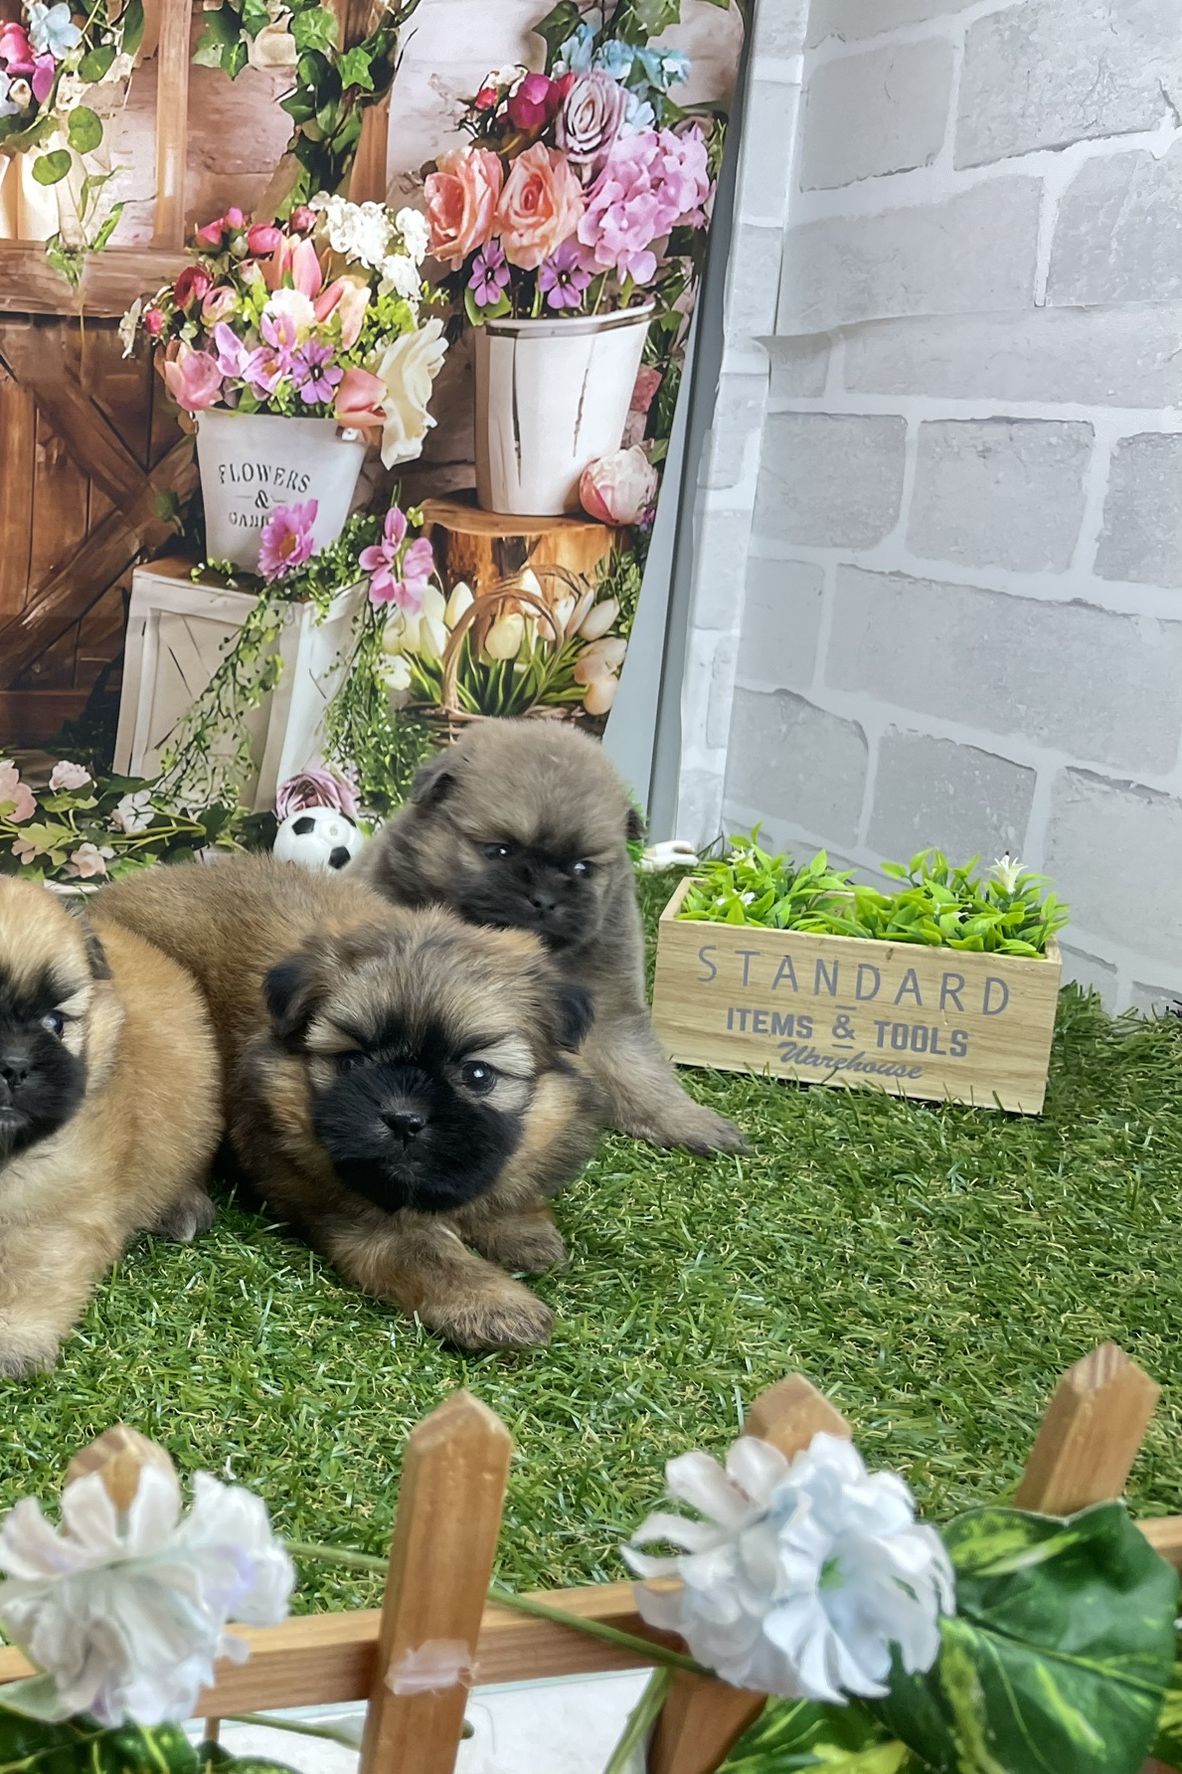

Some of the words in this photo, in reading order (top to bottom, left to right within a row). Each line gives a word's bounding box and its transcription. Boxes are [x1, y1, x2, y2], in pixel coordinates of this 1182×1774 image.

[218, 463, 311, 493] FLOWERS
[254, 489, 269, 509] &
[697, 945, 1010, 1015] STANDARD
[726, 1007, 813, 1039] ITEMS
[831, 1013, 856, 1040] &
[873, 1019, 969, 1057] TOOLS
[777, 1041, 923, 1080] Warehouse
